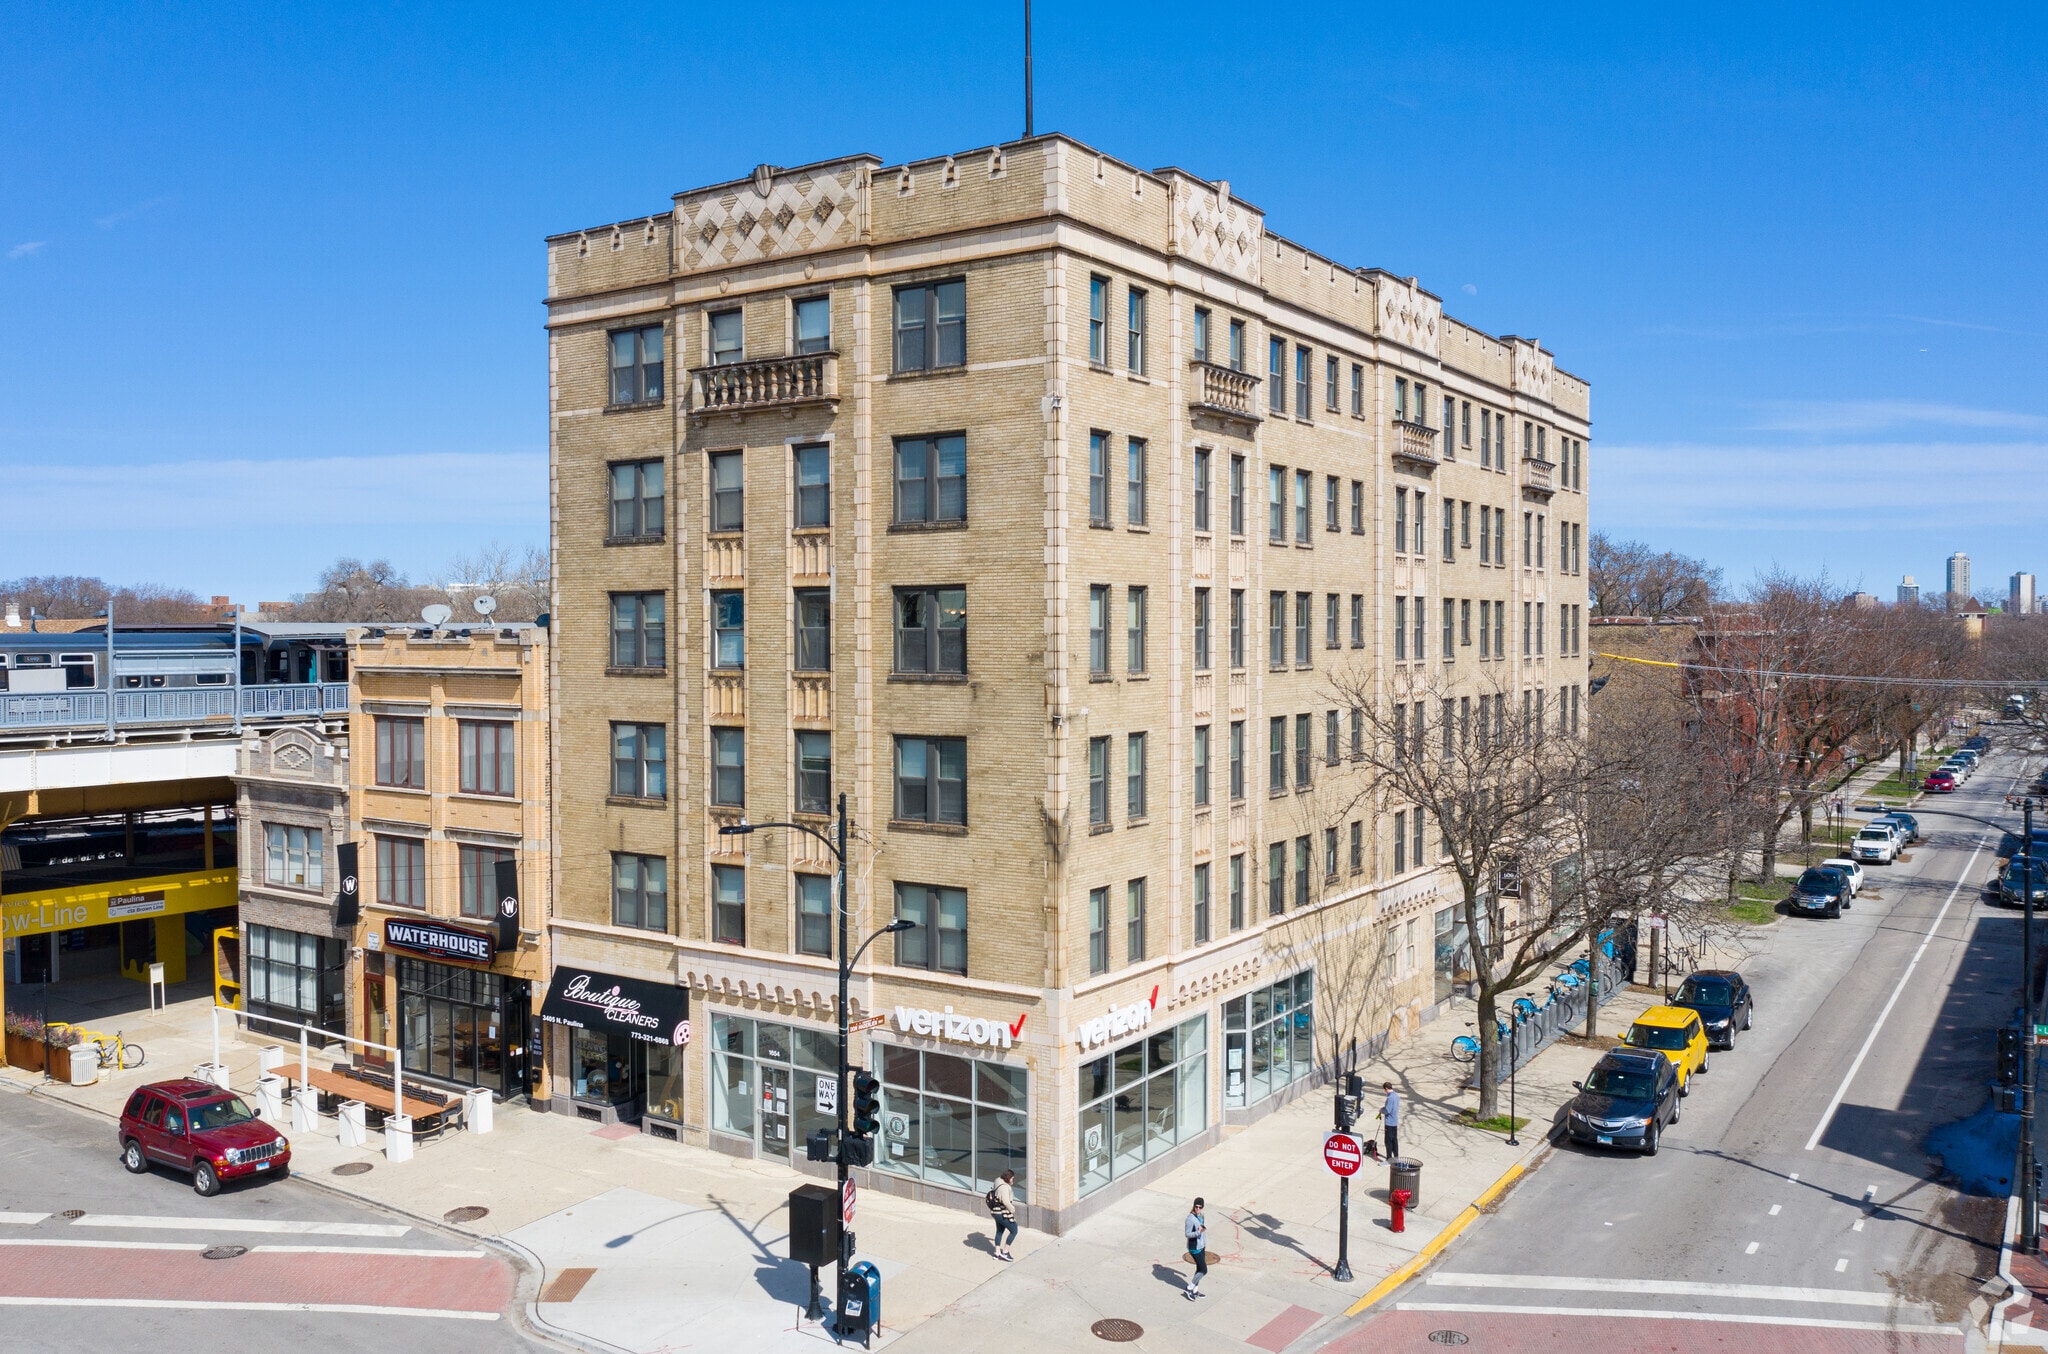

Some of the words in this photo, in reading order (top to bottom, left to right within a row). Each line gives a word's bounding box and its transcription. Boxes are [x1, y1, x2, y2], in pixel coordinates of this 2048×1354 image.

[98, 851, 106, 860] &
[108, 850, 124, 859] Co.
[345, 879, 355, 891] W
[117, 895, 145, 905] Paulina
[504, 900, 515, 914] W
[388, 924, 489, 958] WATERHOUSE
[563, 974, 641, 1014] Boutique
[542, 1014, 555, 1024] 3405
[556, 1016, 562, 1025] N.
[563, 1018, 584, 1029] Paulina
[606, 1009, 660, 1029] CLEANERS
[1078, 999, 1152, 1049] verizon
[895, 1005, 1012, 1049] verizon
[819, 1080, 836, 1091] ONE
[819, 1090, 835, 1100] WAY
[1342, 1143, 1355, 1151] NOT
[1332, 1160, 1353, 1169] ENTER
